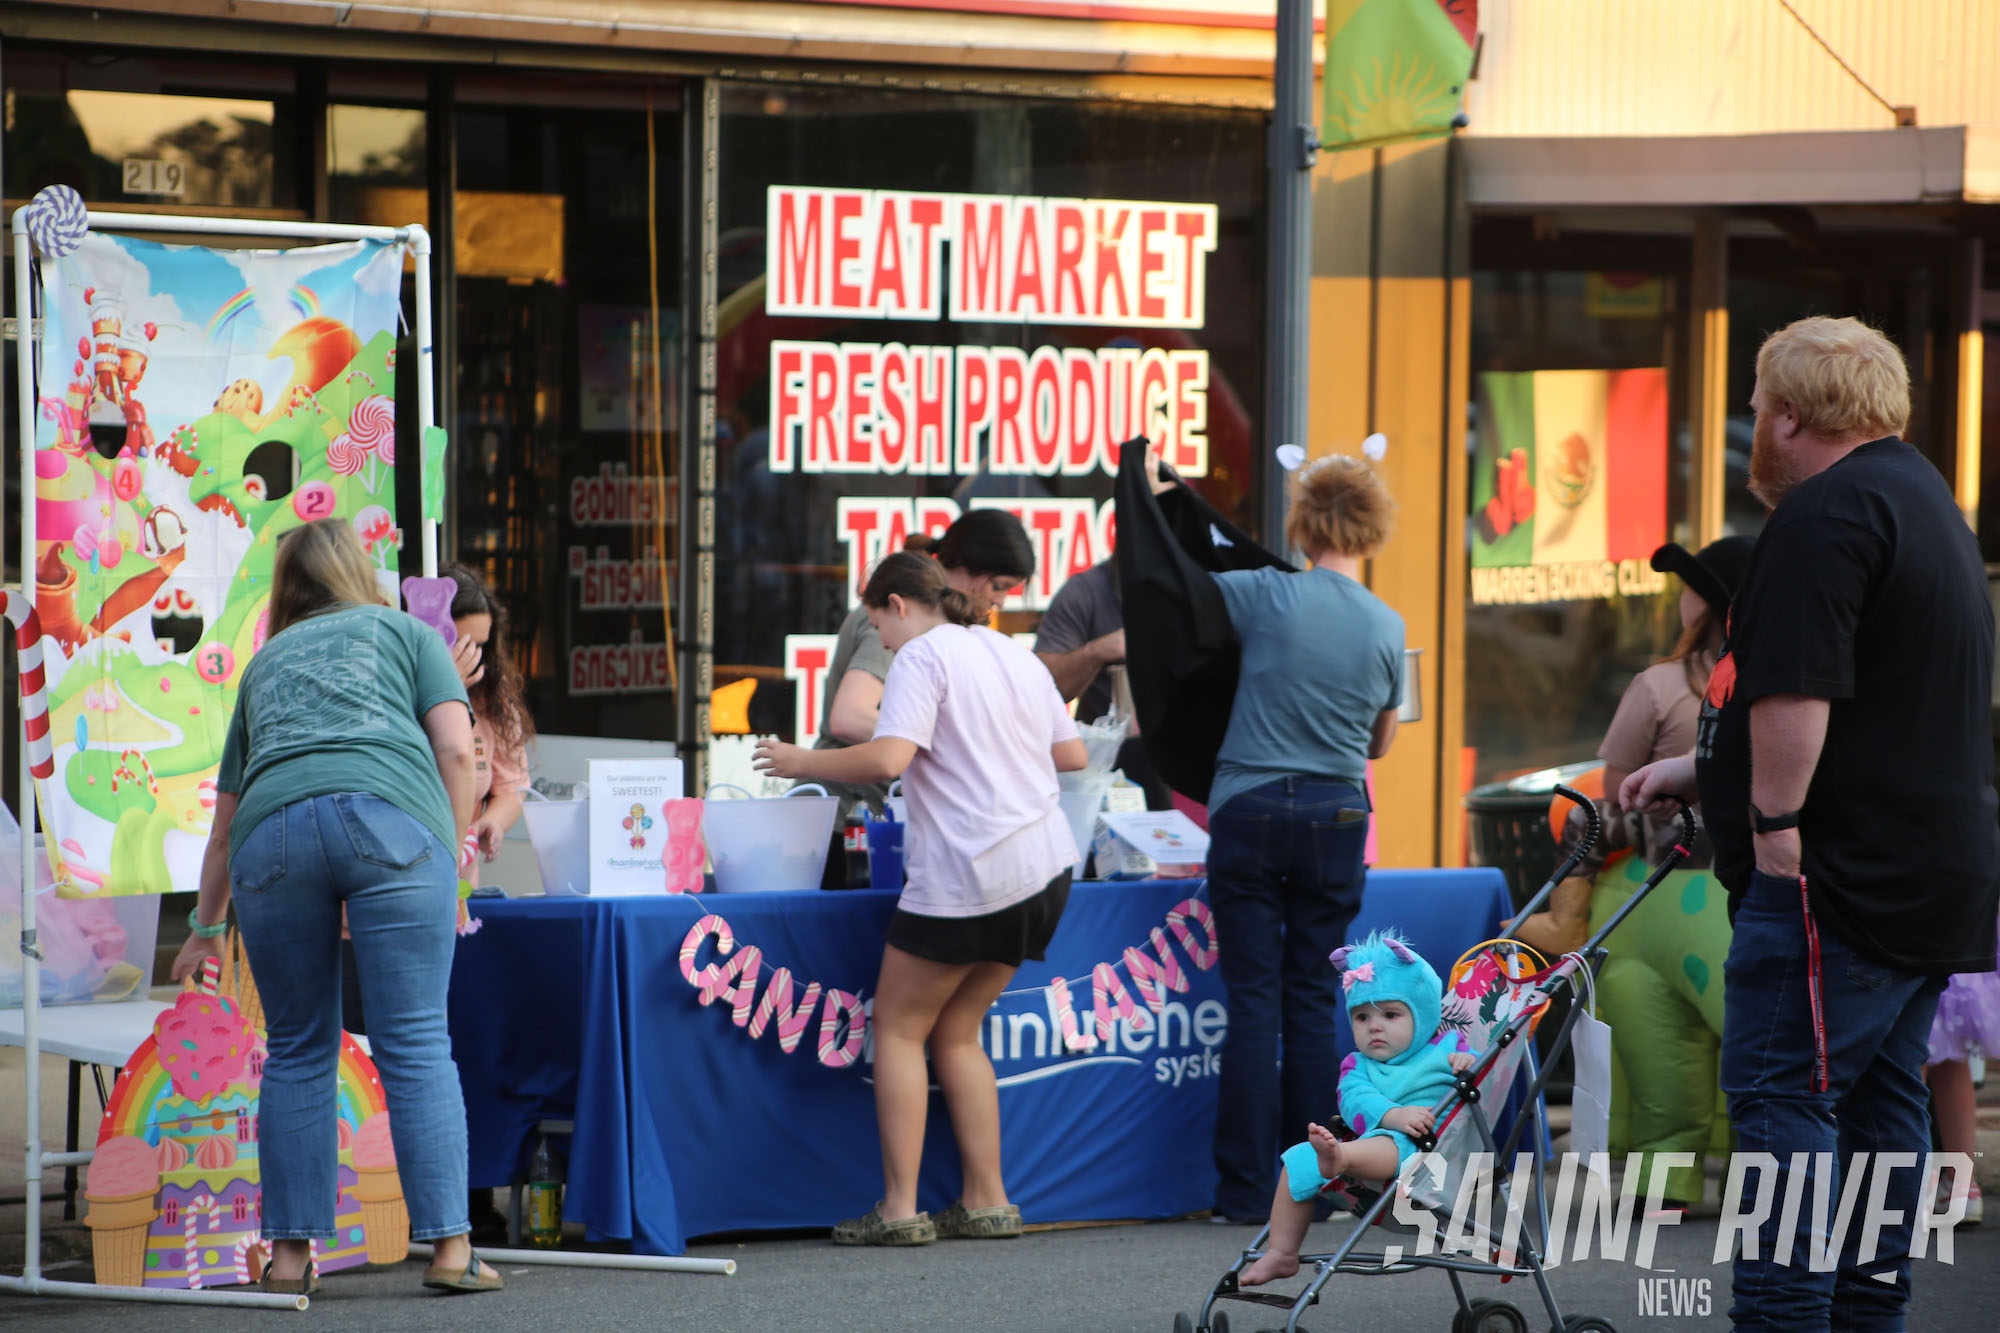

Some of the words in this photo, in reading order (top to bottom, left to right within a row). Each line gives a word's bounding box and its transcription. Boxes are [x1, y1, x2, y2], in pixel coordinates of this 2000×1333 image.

[126, 161, 182, 192] 219
[775, 188, 946, 314] MEAT
[956, 197, 1209, 322] MARKET
[773, 347, 949, 470] FRESH
[960, 351, 1202, 471] PRODUCE
[117, 469, 134, 493] 4
[306, 490, 326, 514] 2
[206, 652, 224, 676] 3
[679, 914, 866, 1067] CAND
[1051, 898, 1219, 1050] LAND
